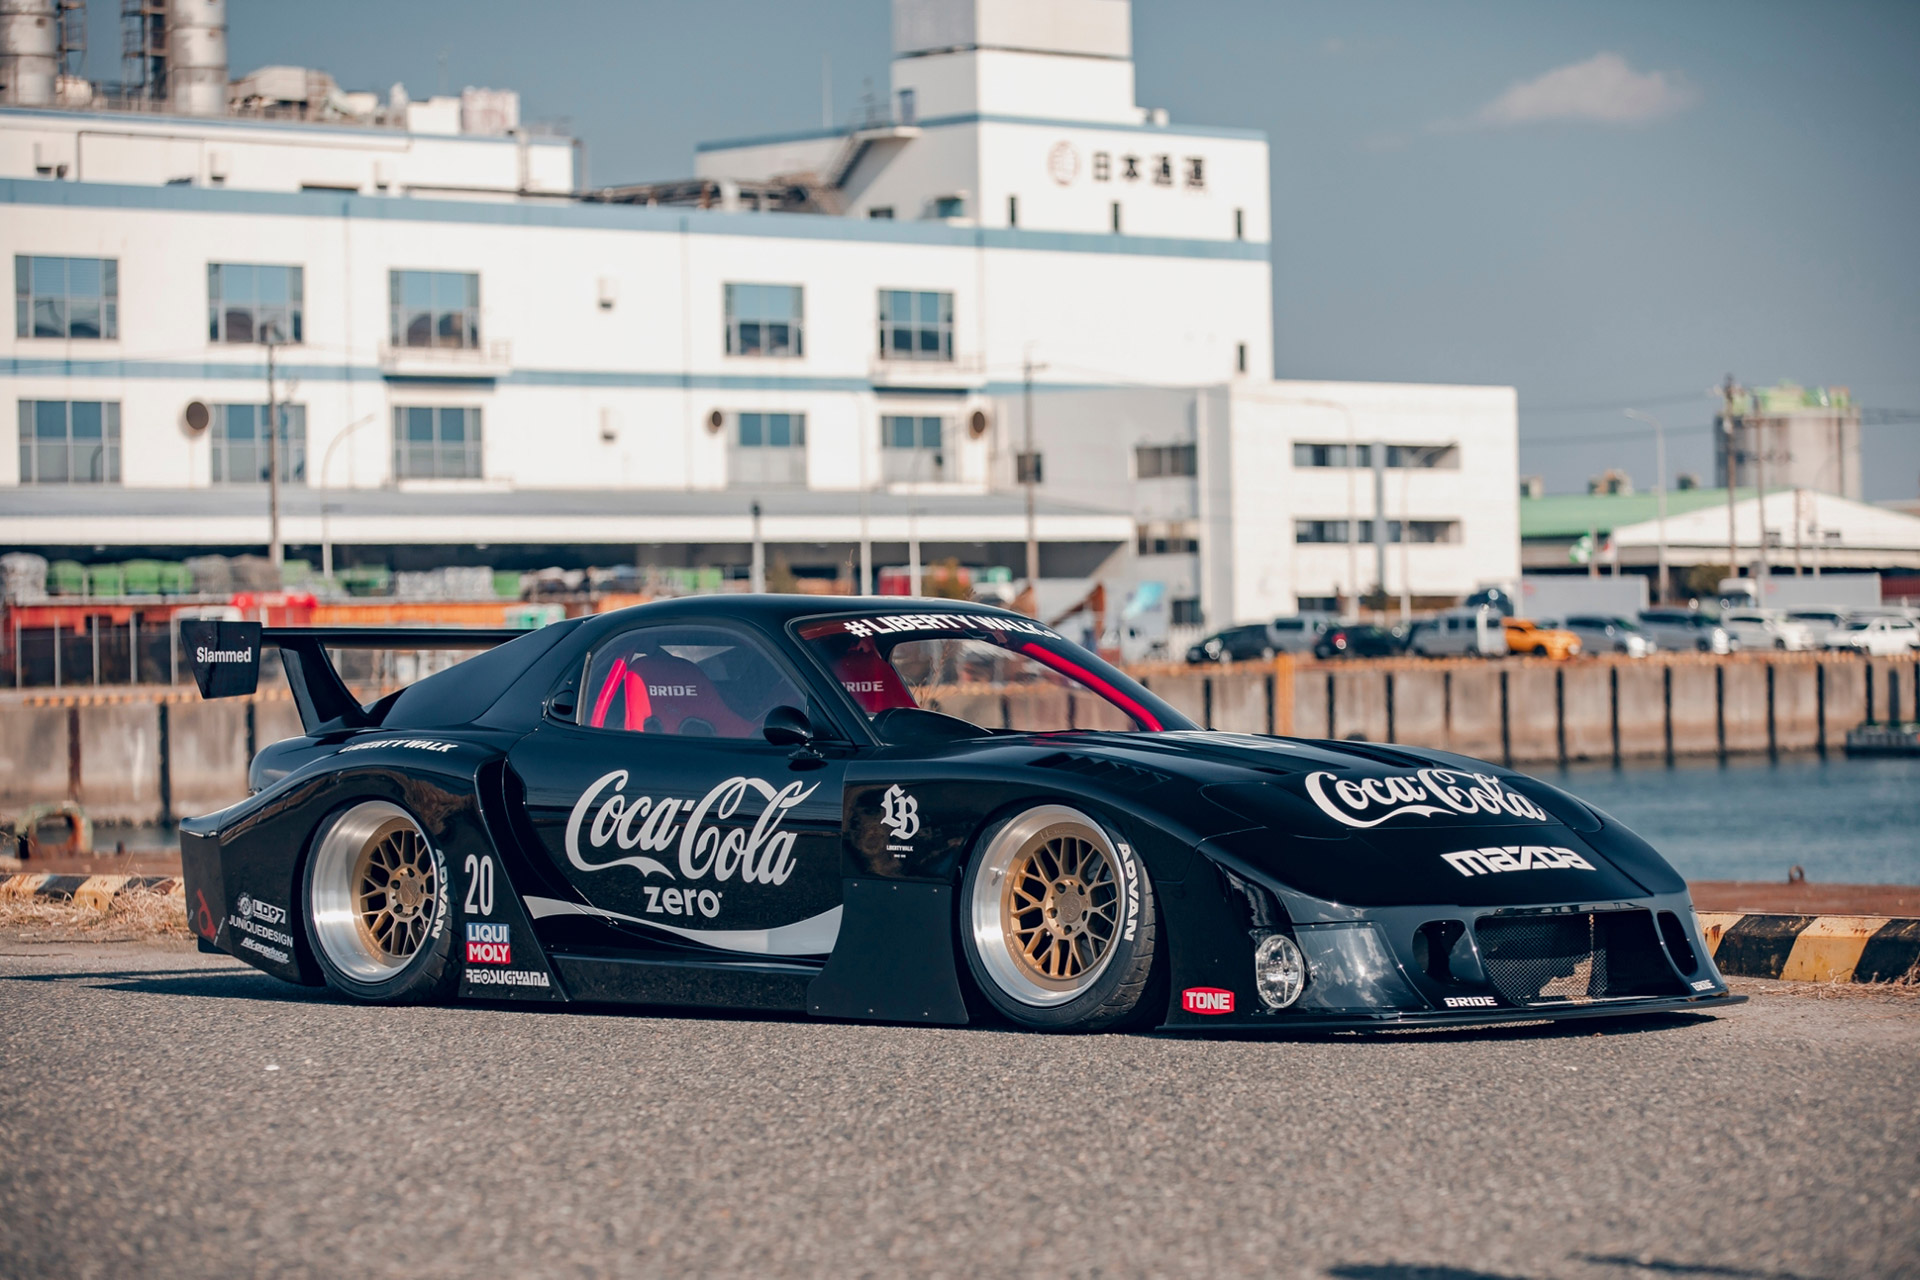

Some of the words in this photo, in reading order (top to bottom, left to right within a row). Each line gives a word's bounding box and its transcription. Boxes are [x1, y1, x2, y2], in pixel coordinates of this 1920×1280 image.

[196, 646, 252, 663] Slammed
[649, 685, 698, 697] BRIDE
[841, 680, 884, 692] RIDE
[1305, 768, 1547, 828] Coca-Cola
[565, 769, 822, 887] Coca-Cola
[431, 848, 449, 940] ADVAN
[464, 854, 494, 916] 20
[1117, 842, 1140, 942] ADVAN
[643, 885, 721, 919] zero
[468, 924, 508, 943] LIQUI
[468, 943, 510, 962] MOLY
[1186, 991, 1231, 1010] TONE
[1443, 996, 1498, 1008] BRIDE
